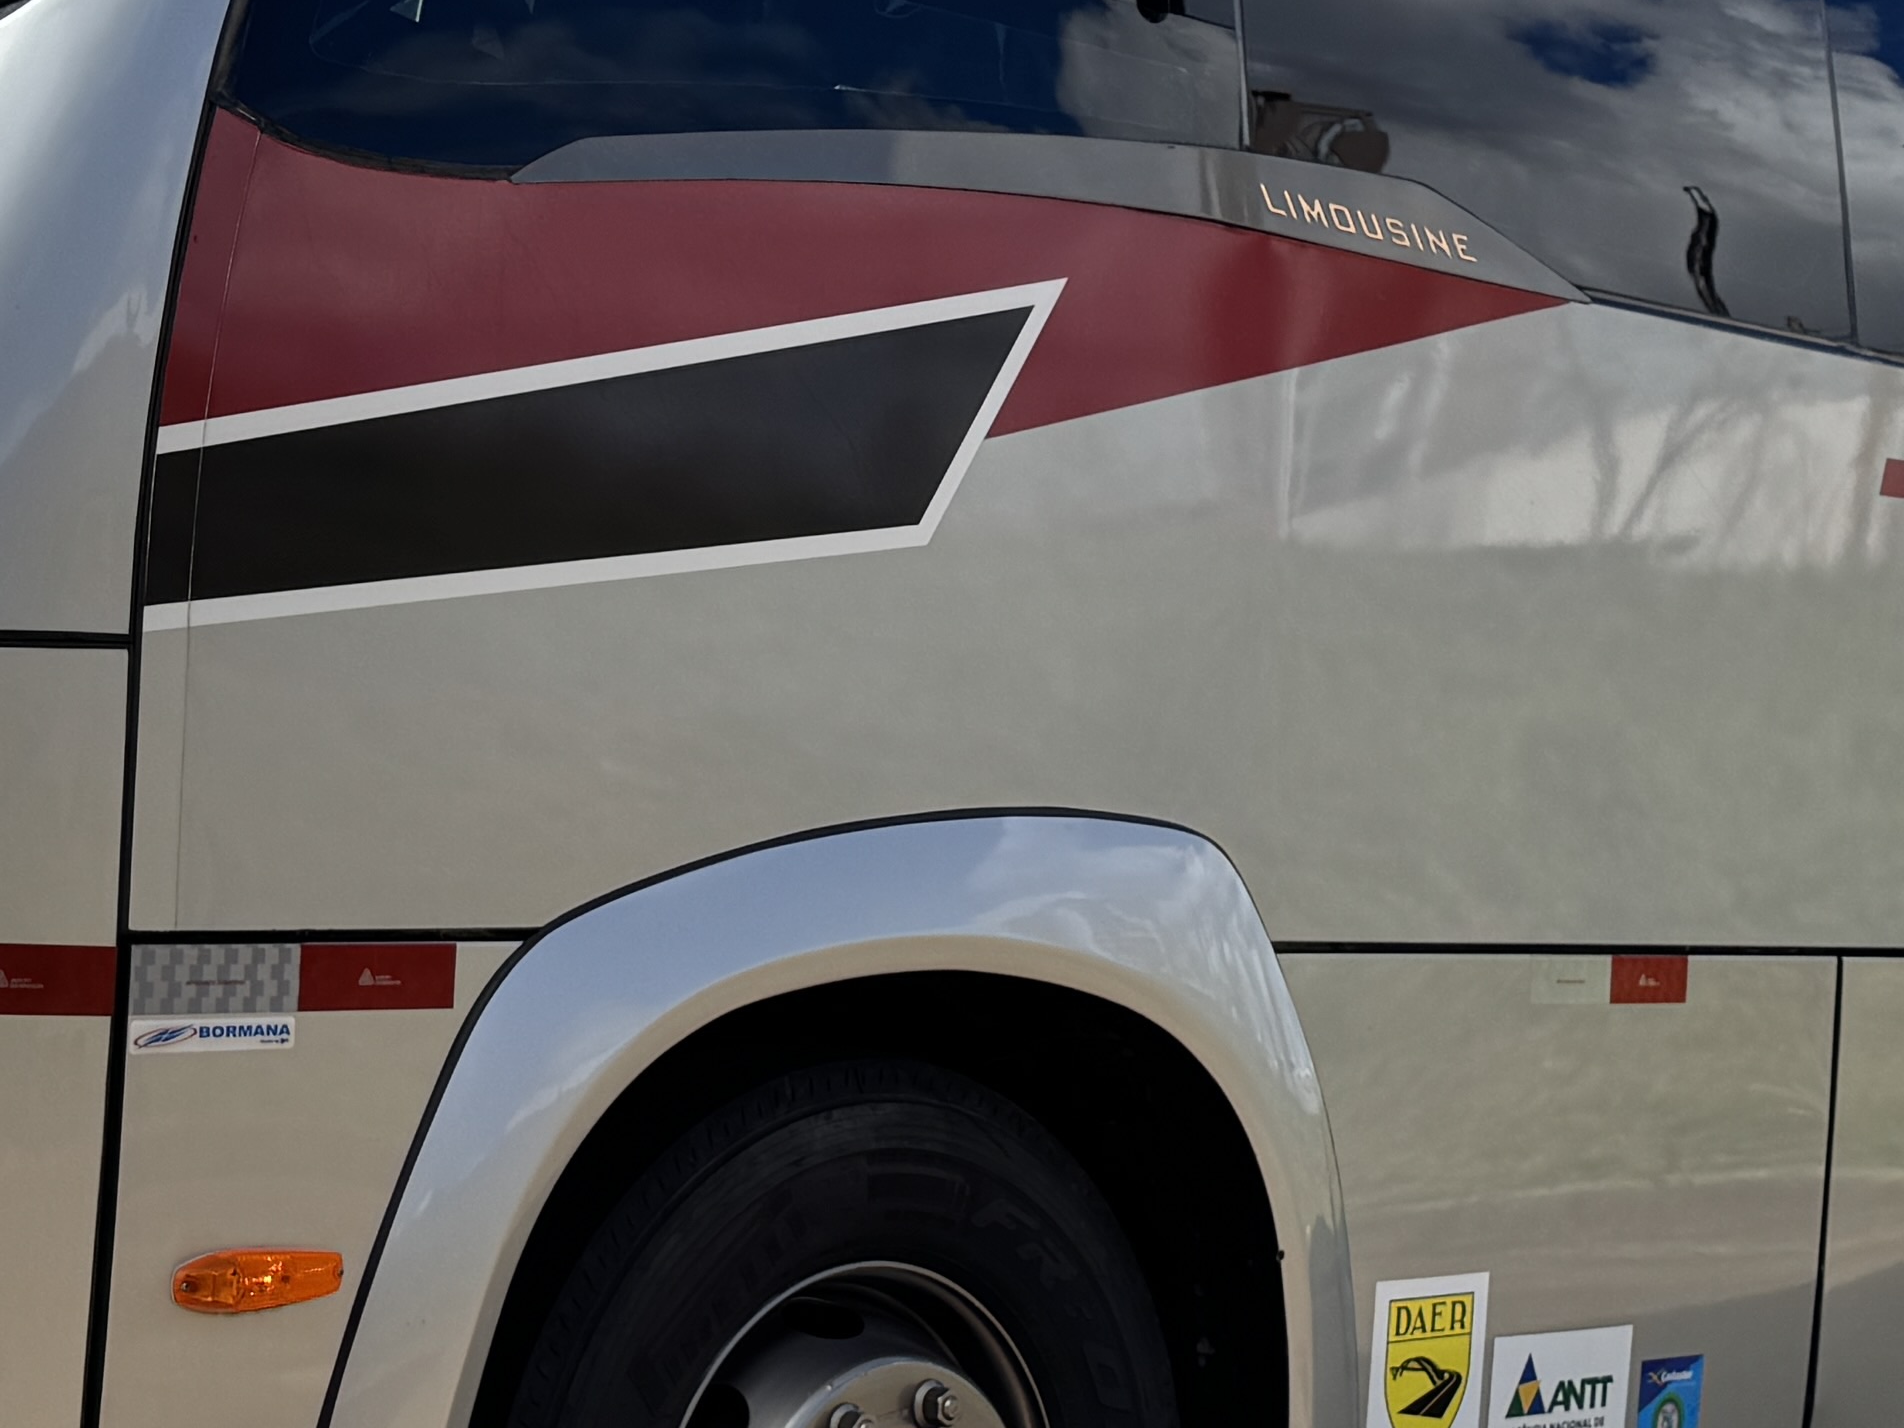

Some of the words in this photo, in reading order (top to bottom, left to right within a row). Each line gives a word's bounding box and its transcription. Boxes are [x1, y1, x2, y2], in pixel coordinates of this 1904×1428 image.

[1259, 182, 1478, 263] LIMOUSINE
[198, 1023, 291, 1039] BORMANA
[1394, 1299, 1468, 1337] DAER
[1546, 1374, 1614, 1414] ANTT
